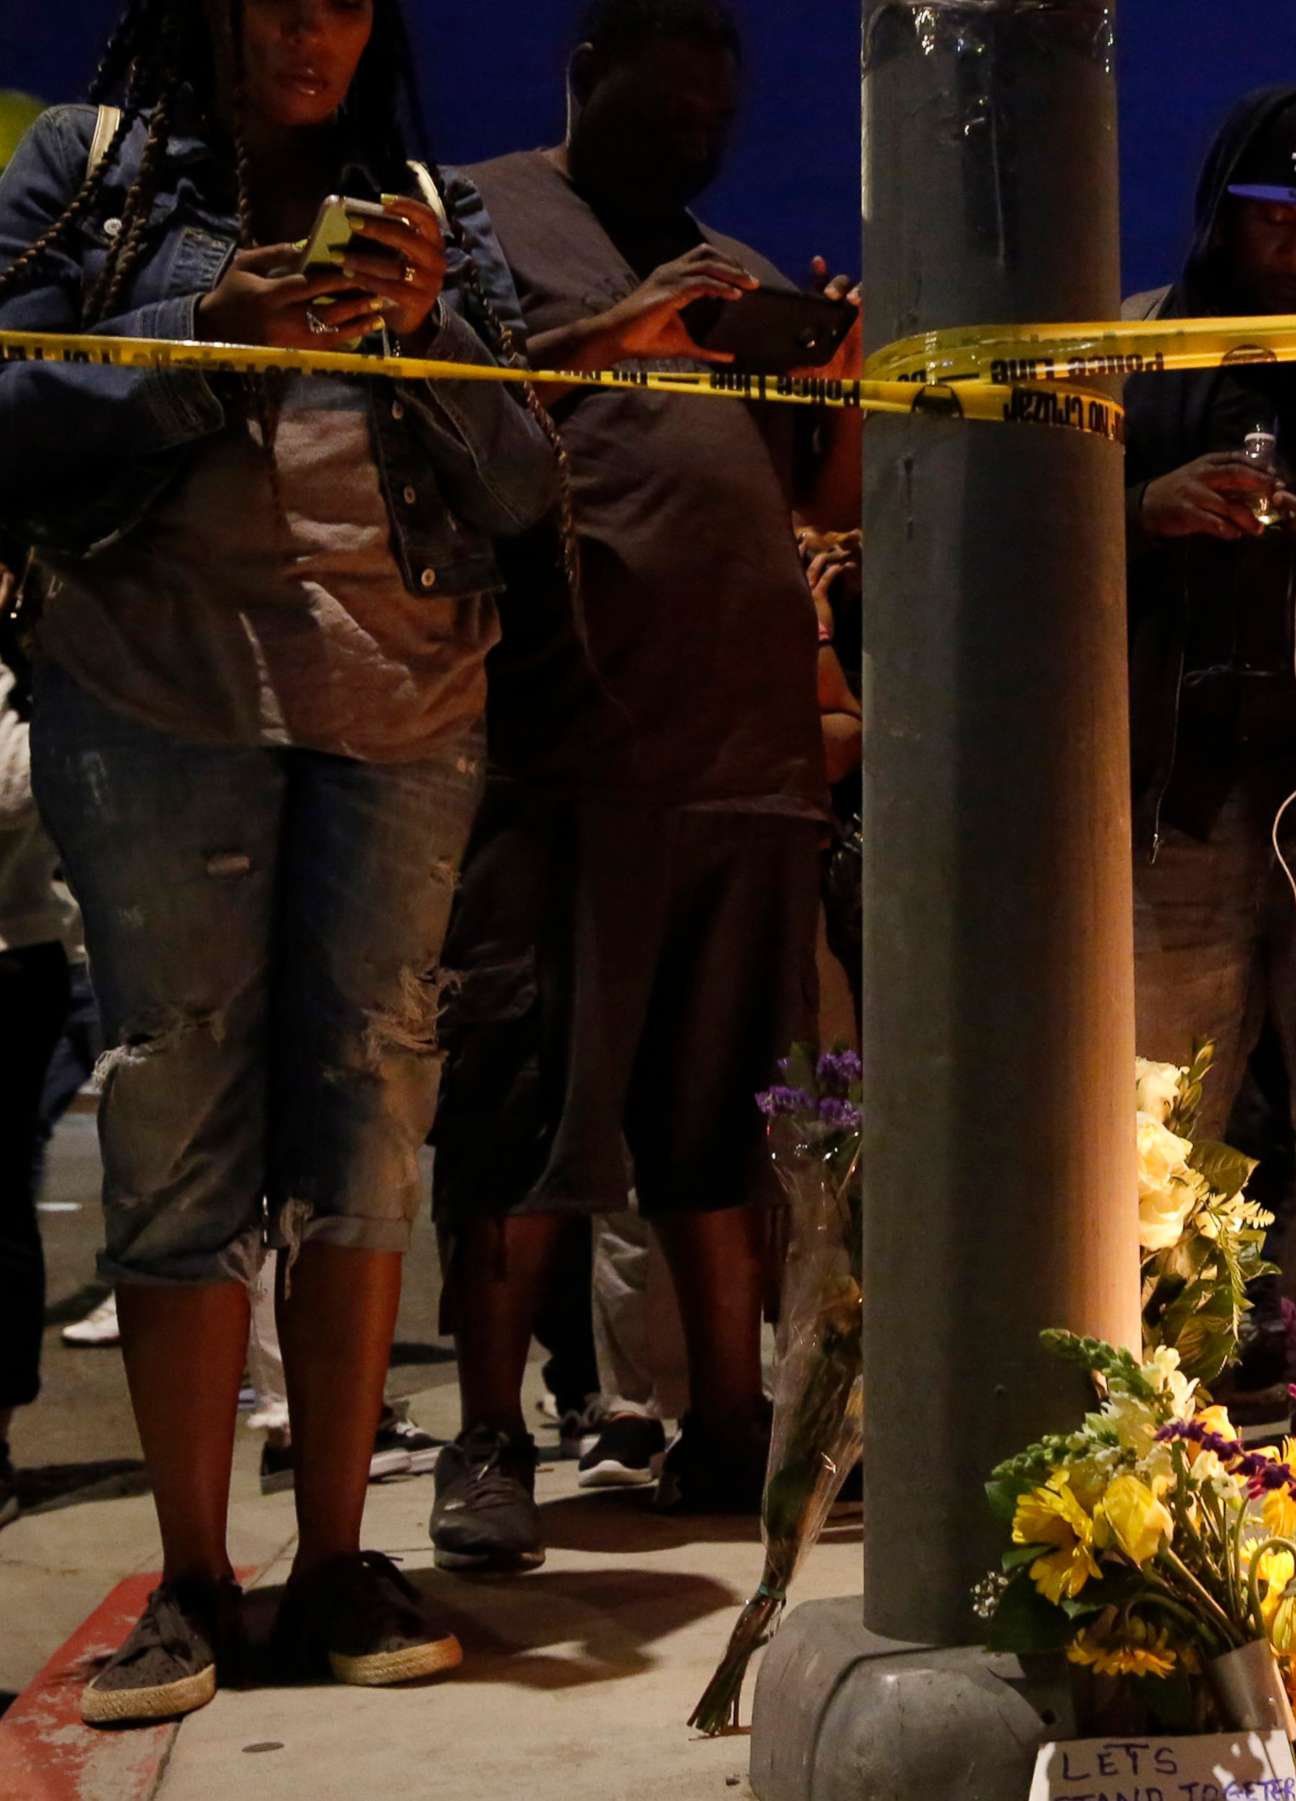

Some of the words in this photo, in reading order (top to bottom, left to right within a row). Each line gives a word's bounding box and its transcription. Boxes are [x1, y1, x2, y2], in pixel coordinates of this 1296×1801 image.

[990, 358, 1055, 386] Line
[1067, 352, 1165, 377] Police
[776, 379, 862, 408] Police
[1003, 387, 1085, 430] Cruzar
[1062, 1743, 1179, 1780] LETS
